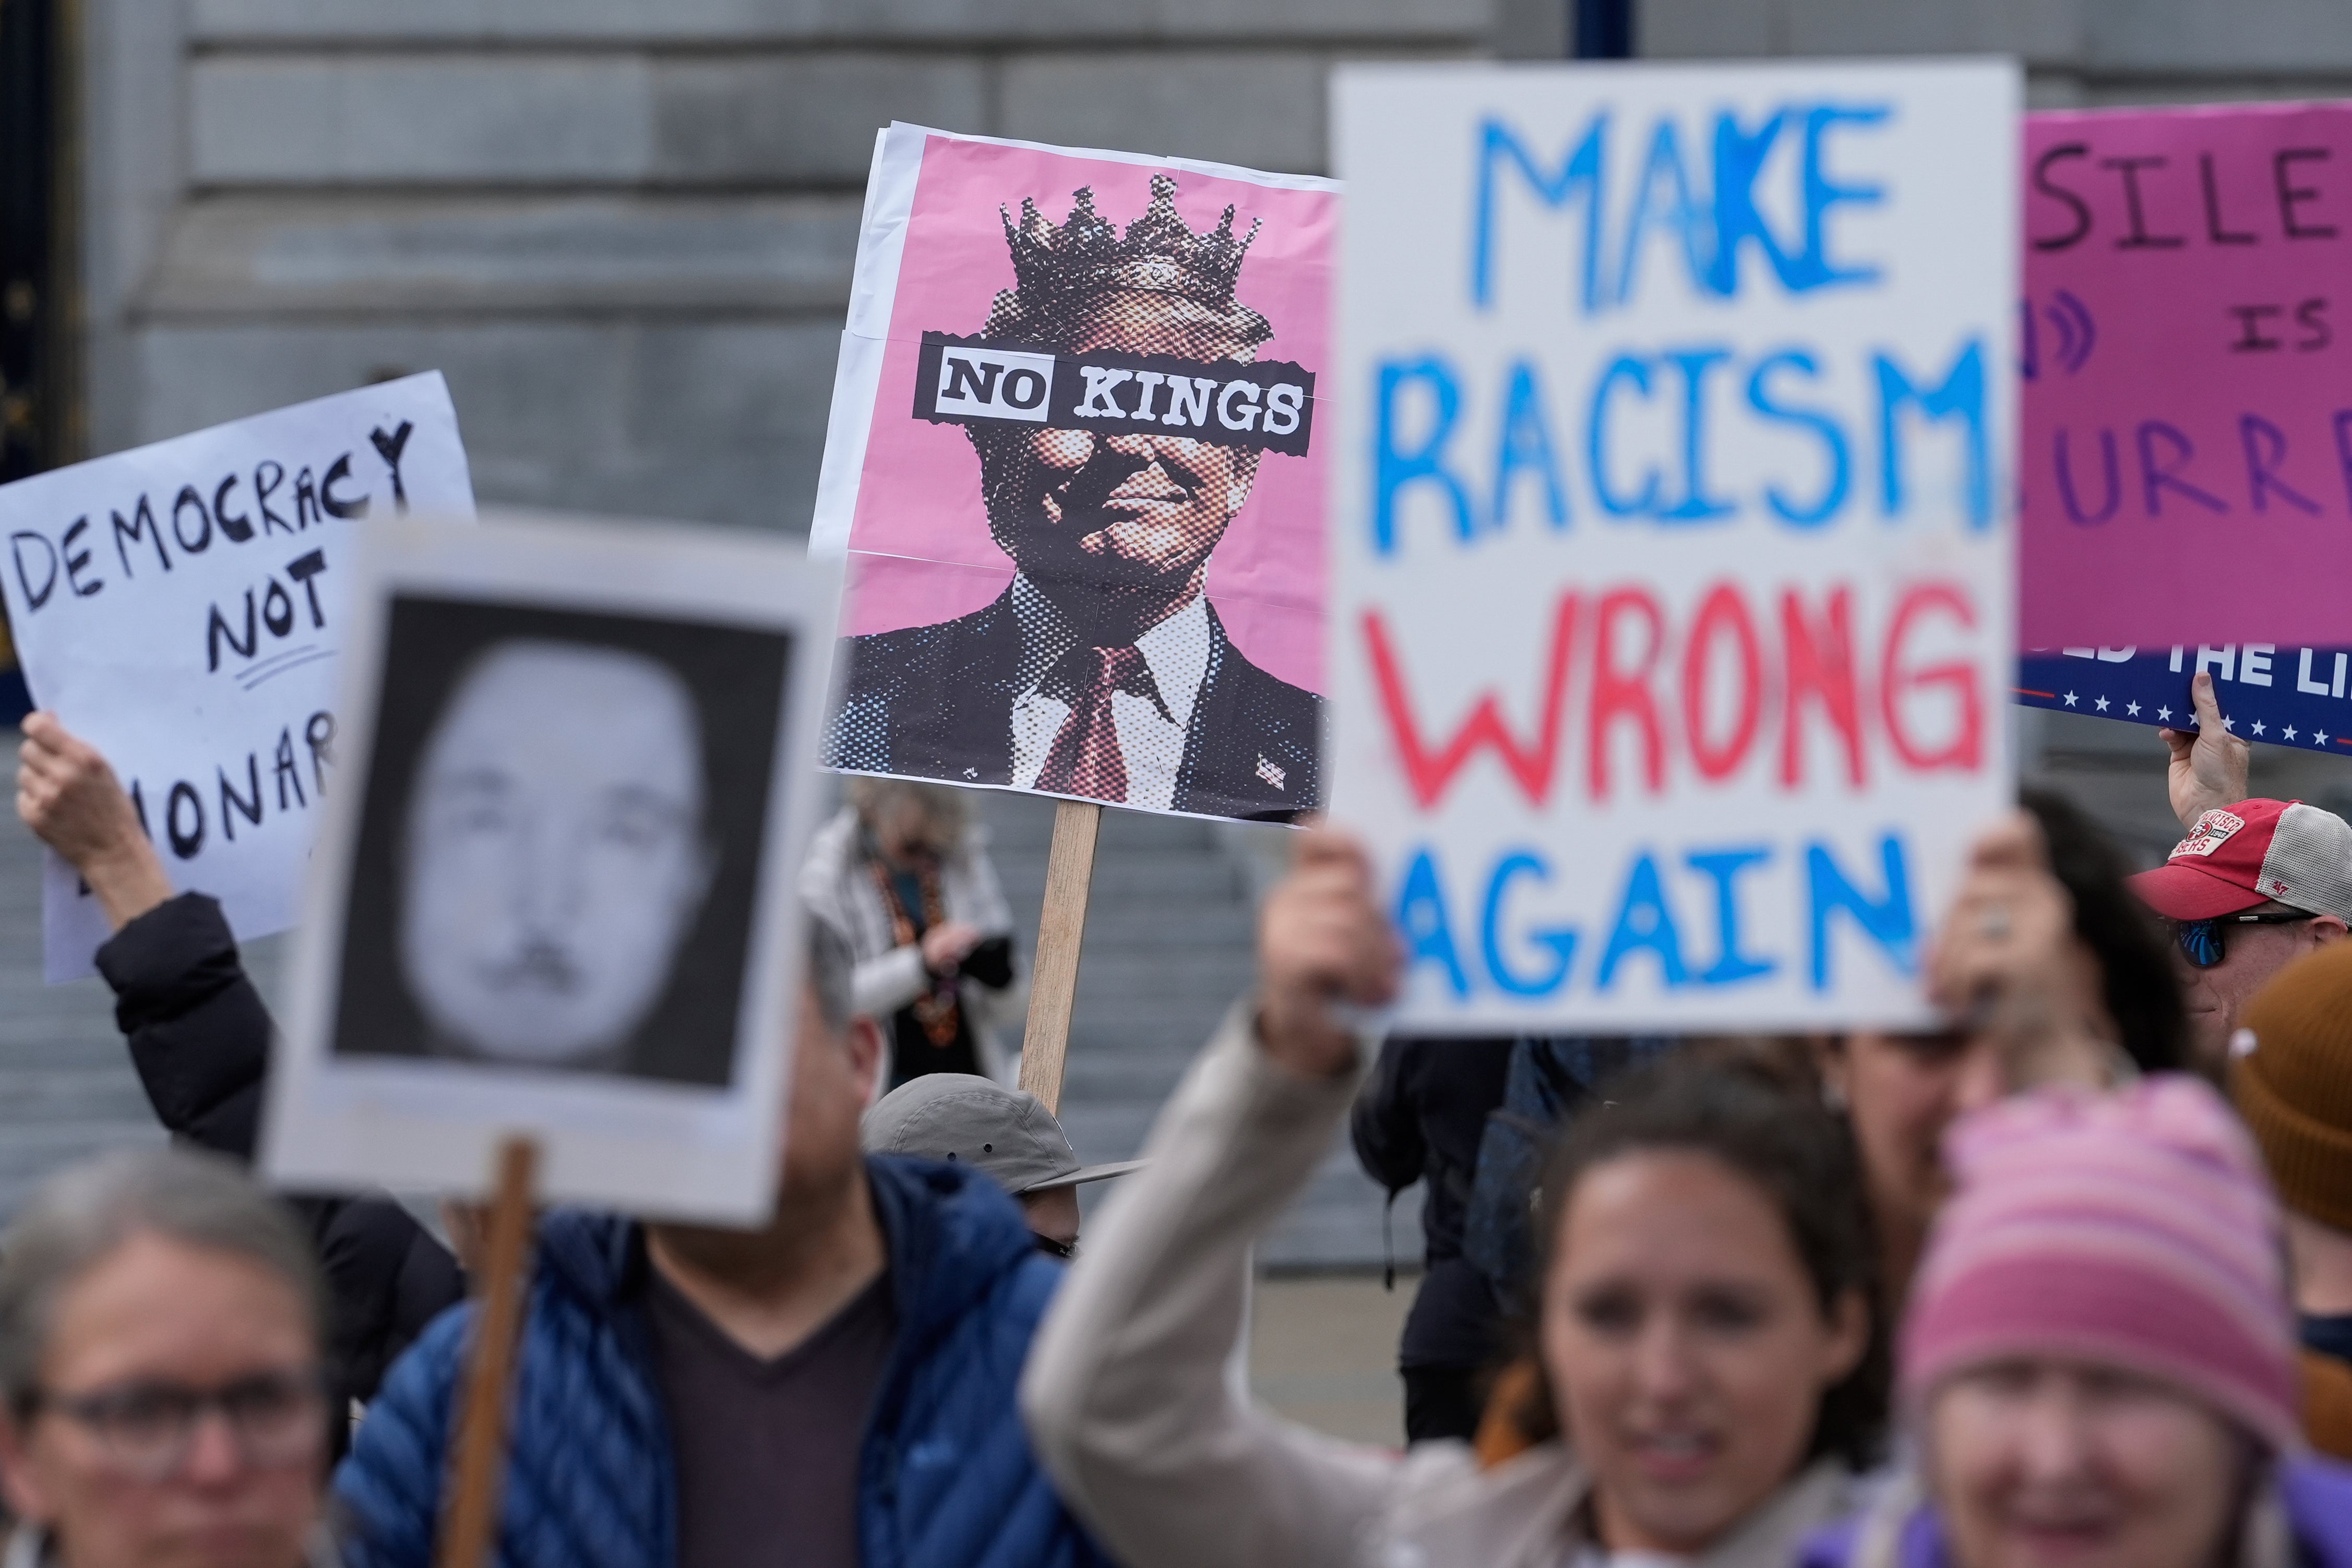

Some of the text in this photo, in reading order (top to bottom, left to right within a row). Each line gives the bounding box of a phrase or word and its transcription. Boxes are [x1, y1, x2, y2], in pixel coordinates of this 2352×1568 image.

[1471, 100, 1893, 315] MAKE
[942, 357, 1304, 435] NO KINGS
[2230, 297, 2331, 354] IS
[10, 420, 414, 614] DEMOCRACY
[1368, 330, 1996, 558] RACISM
[2019, 408, 2352, 528] URR
[207, 547, 328, 673] NOT
[2297, 647, 2352, 699] LI
[1361, 580, 1988, 811] WRONG
[1392, 831, 1921, 1004] AGAIN
